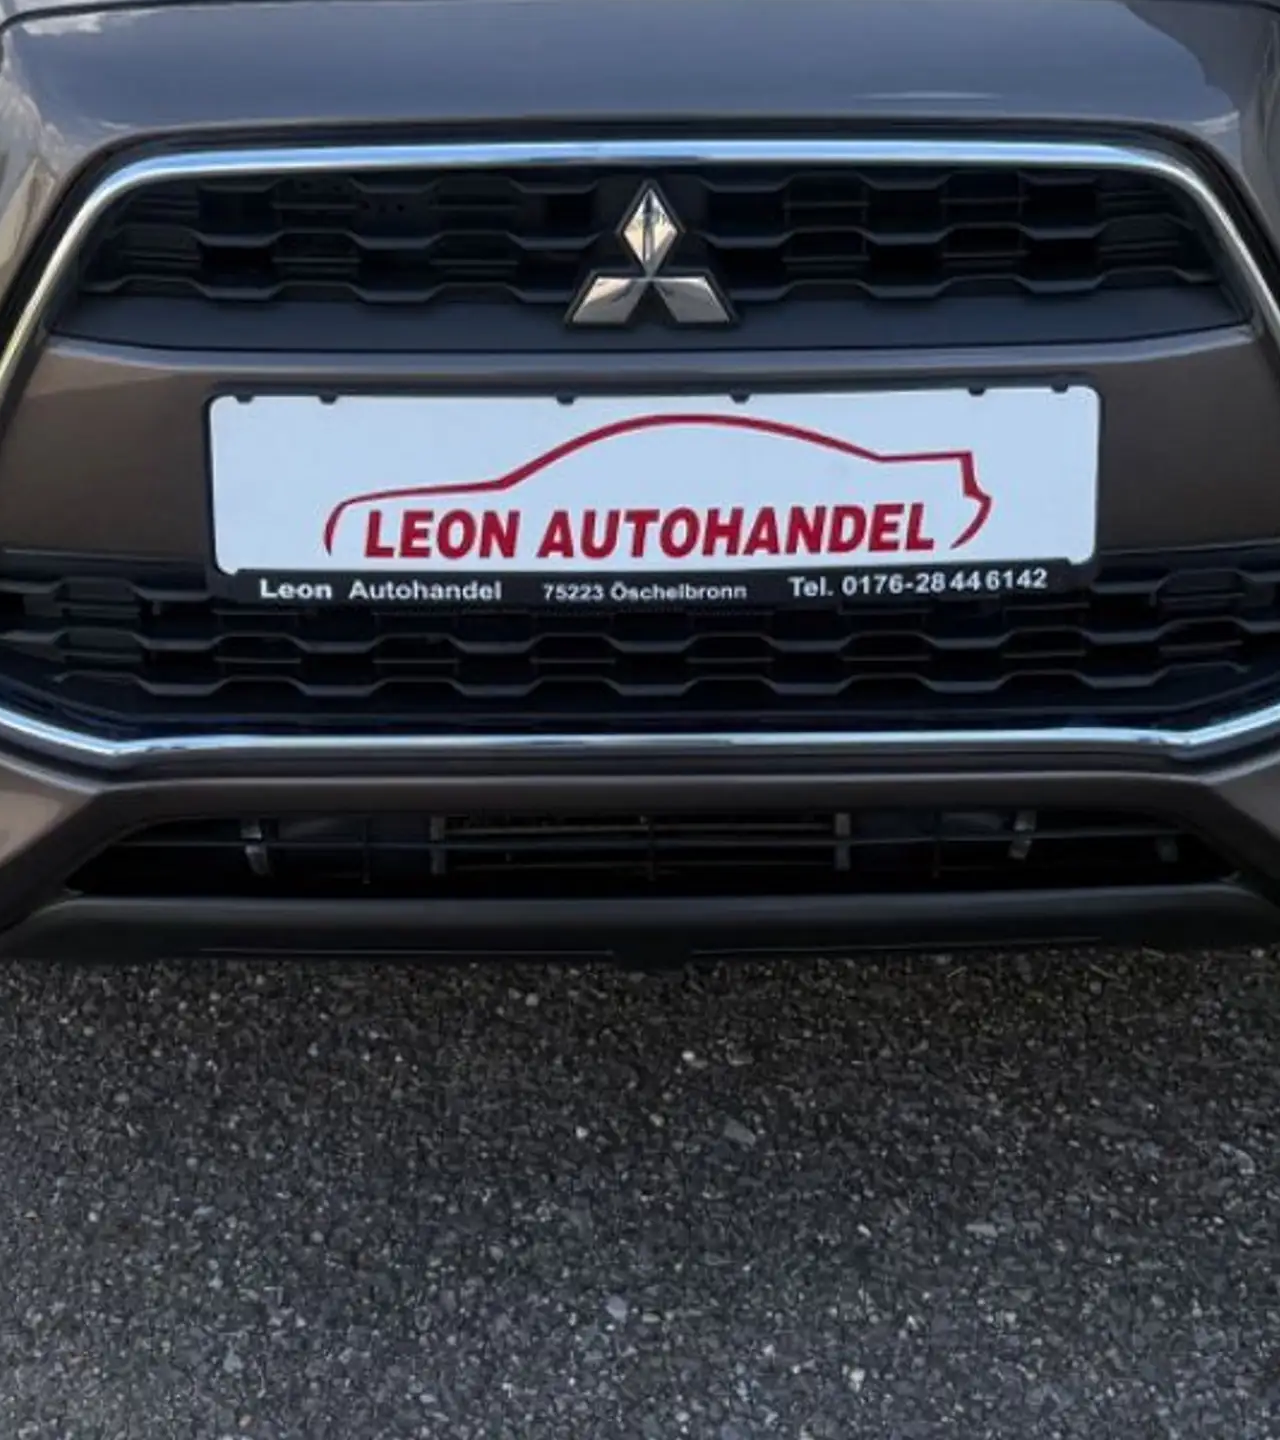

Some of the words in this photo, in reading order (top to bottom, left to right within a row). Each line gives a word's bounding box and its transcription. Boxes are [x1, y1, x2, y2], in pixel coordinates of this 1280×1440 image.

[364, 509, 521, 560] LEON
[537, 503, 937, 560] AUTOHANDEL
[258, 578, 333, 600] Leon
[348, 578, 503, 601] Autohandel
[542, 582, 605, 602] 75223
[609, 580, 748, 602] Öschelbronn
[787, 575, 834, 598] Tel.
